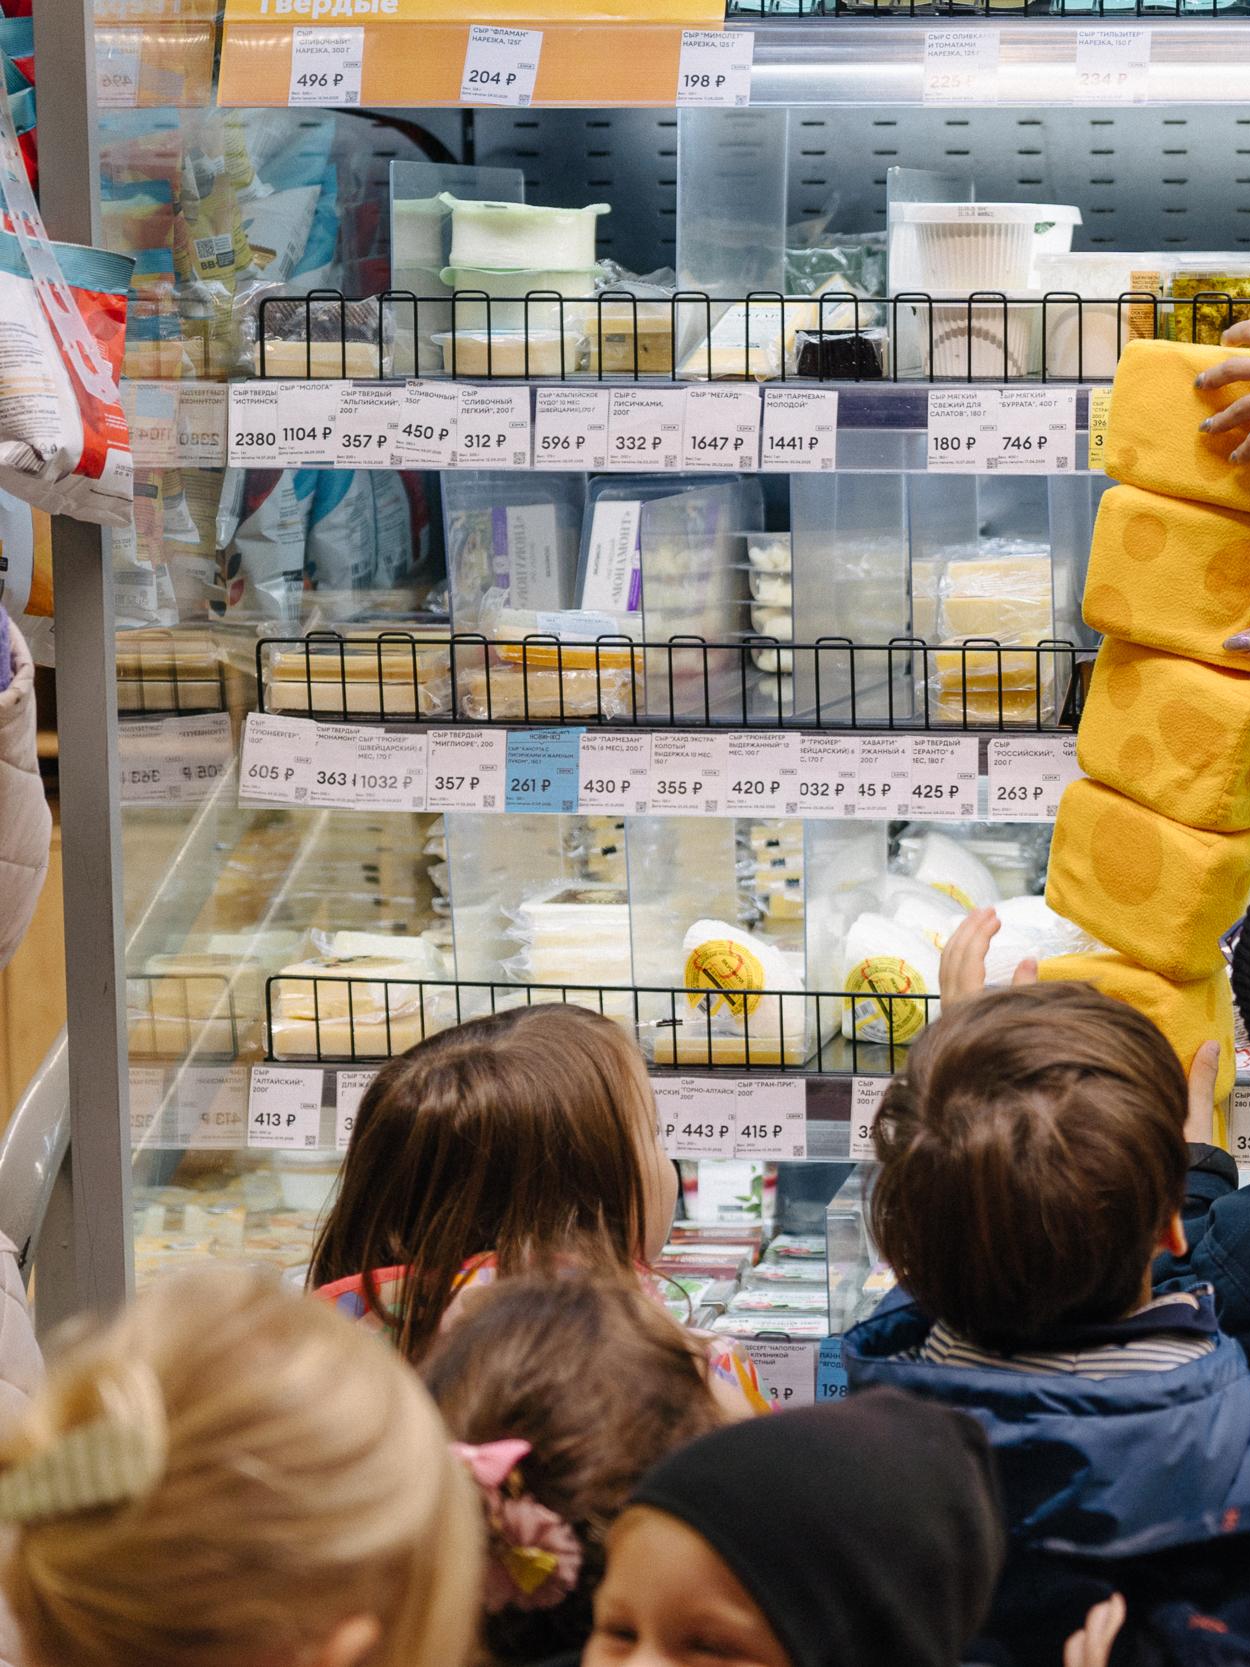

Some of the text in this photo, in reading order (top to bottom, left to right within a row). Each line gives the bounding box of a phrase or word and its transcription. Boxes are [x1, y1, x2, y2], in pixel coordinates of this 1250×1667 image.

[259, 0, 399, 19] Твердые
[297, 73, 328, 87] 496
[469, 70, 501, 84] 204
[684, 75, 710, 88] 198
[461, 406, 494, 415] ЛЕГКИЙ",
[496, 406, 510, 415] 200
[614, 401, 663, 409] ЛИСИЧКАМИ,
[767, 401, 808, 409] МОЛОДОЙ"
[930, 401, 982, 409] "СВЕЖИЙ ДЛЯ
[283, 427, 316, 442] 1104
[402, 424, 434, 439] 450
[235, 433, 276, 446] 2380
[342, 434, 372, 448] 357
[464, 434, 491, 448] 312
[541, 436, 570, 449] 596
[615, 436, 647, 450] 332
[691, 436, 727, 450] 1647
[769, 436, 803, 450] 1441
[933, 436, 960, 450] 180
[1002, 436, 1032, 450] 746
[994, 750, 1055, 758] "РОССИЙСКИЙ",
[248, 766, 279, 780] 605
[317, 772, 347, 786] 363
[361, 775, 398, 789] 1032
[435, 776, 465, 791] 357
[511, 778, 537, 793] 261
[583, 780, 615, 794] 430
[656, 780, 686, 795] 355
[732, 781, 765, 794] 420
[912, 784, 943, 798] 425
[997, 787, 1027, 800] 263
[253, 1077, 305, 1086] "АЛТАЙСКИЙ",
[254, 1113, 281, 1126] 413
[682, 1124, 714, 1138] 443
[741, 1125, 768, 1138] 415
[822, 1384, 848, 1396] 198
